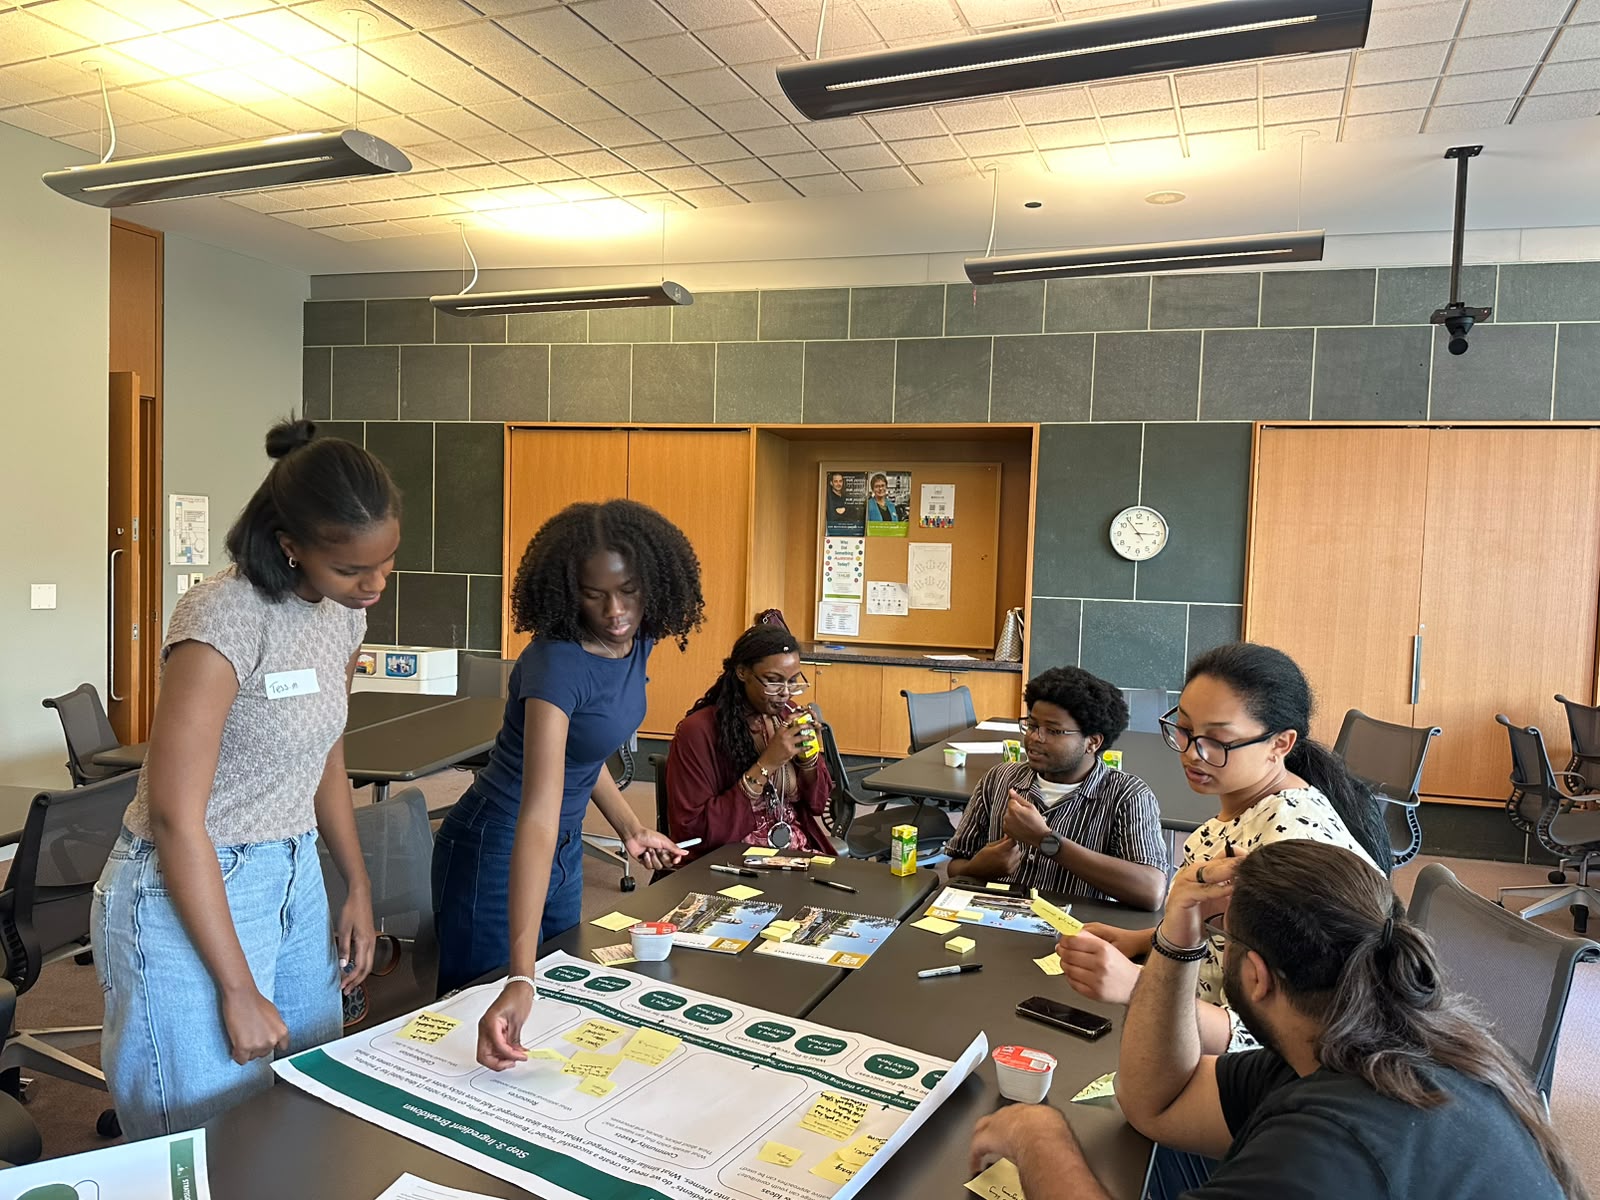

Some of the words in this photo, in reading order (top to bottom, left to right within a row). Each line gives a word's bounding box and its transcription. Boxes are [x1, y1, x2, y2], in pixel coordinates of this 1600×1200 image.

[424, 1086, 440, 1094] notes
[448, 1087, 466, 1096] sticky
[440, 1093, 458, 1102] sticky
[465, 1094, 482, 1102] more
[508, 1092, 539, 1106] Resources
[466, 1104, 482, 1112] write
[402, 1104, 452, 1126] Breakdown
[492, 1108, 525, 1120] emerged?
[494, 1116, 530, 1131] Brainstorm
[524, 1118, 542, 1126] ideas
[449, 1123, 497, 1146] Ingredient
[542, 1124, 565, 1134] unique
[564, 1133, 583, 1142] What
[615, 1133, 638, 1144] Assets
[506, 1146, 530, 1158] Step
[556, 1140, 593, 1155] successful
[582, 1140, 618, 1156] emerged?
[637, 1142, 678, 1158] Community
[598, 1156, 621, 1167] create
[617, 1154, 637, 1164] ideas
[637, 1162, 661, 1171] similar
[660, 1169, 682, 1180] What
[684, 1178, 713, 1194] themes.
[761, 1188, 782, 1199] Ideas
